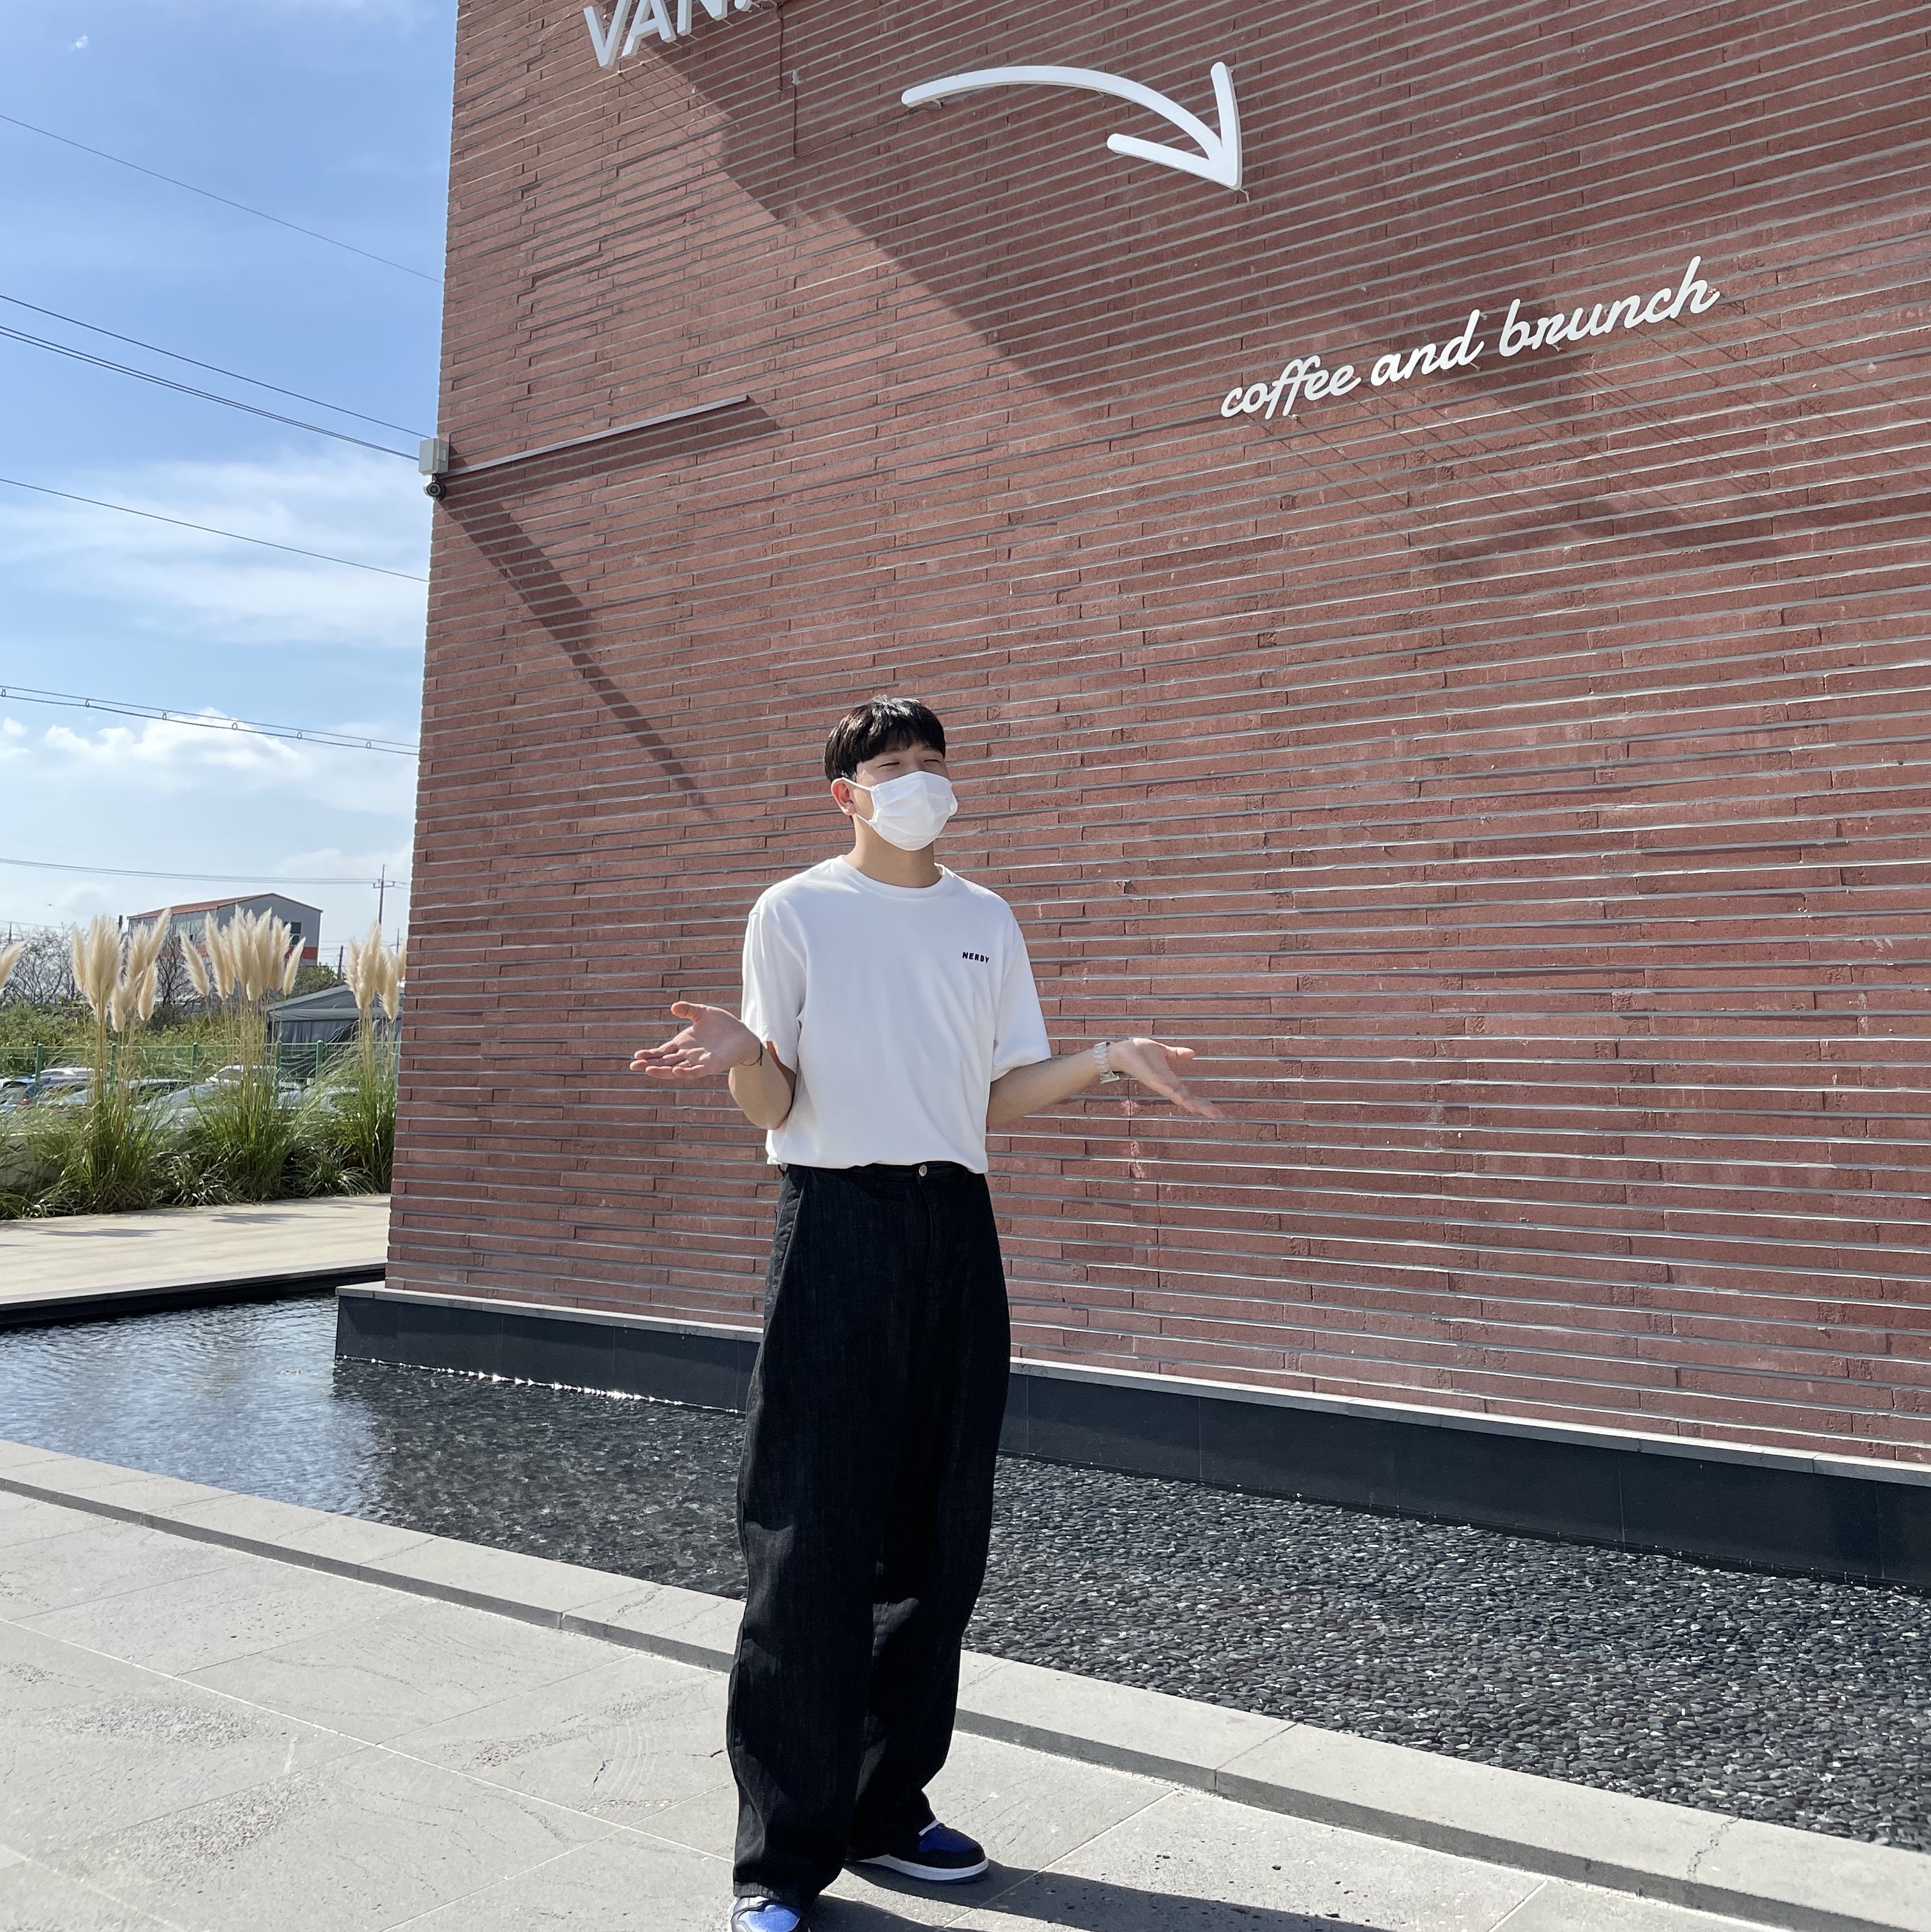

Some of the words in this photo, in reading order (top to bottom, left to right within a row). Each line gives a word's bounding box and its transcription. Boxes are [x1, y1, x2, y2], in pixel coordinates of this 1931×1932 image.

[1220, 355, 1361, 420] coffee
[1370, 309, 1485, 386] and
[1499, 255, 1720, 358] brunch
[962, 952, 990, 963] NERDY
